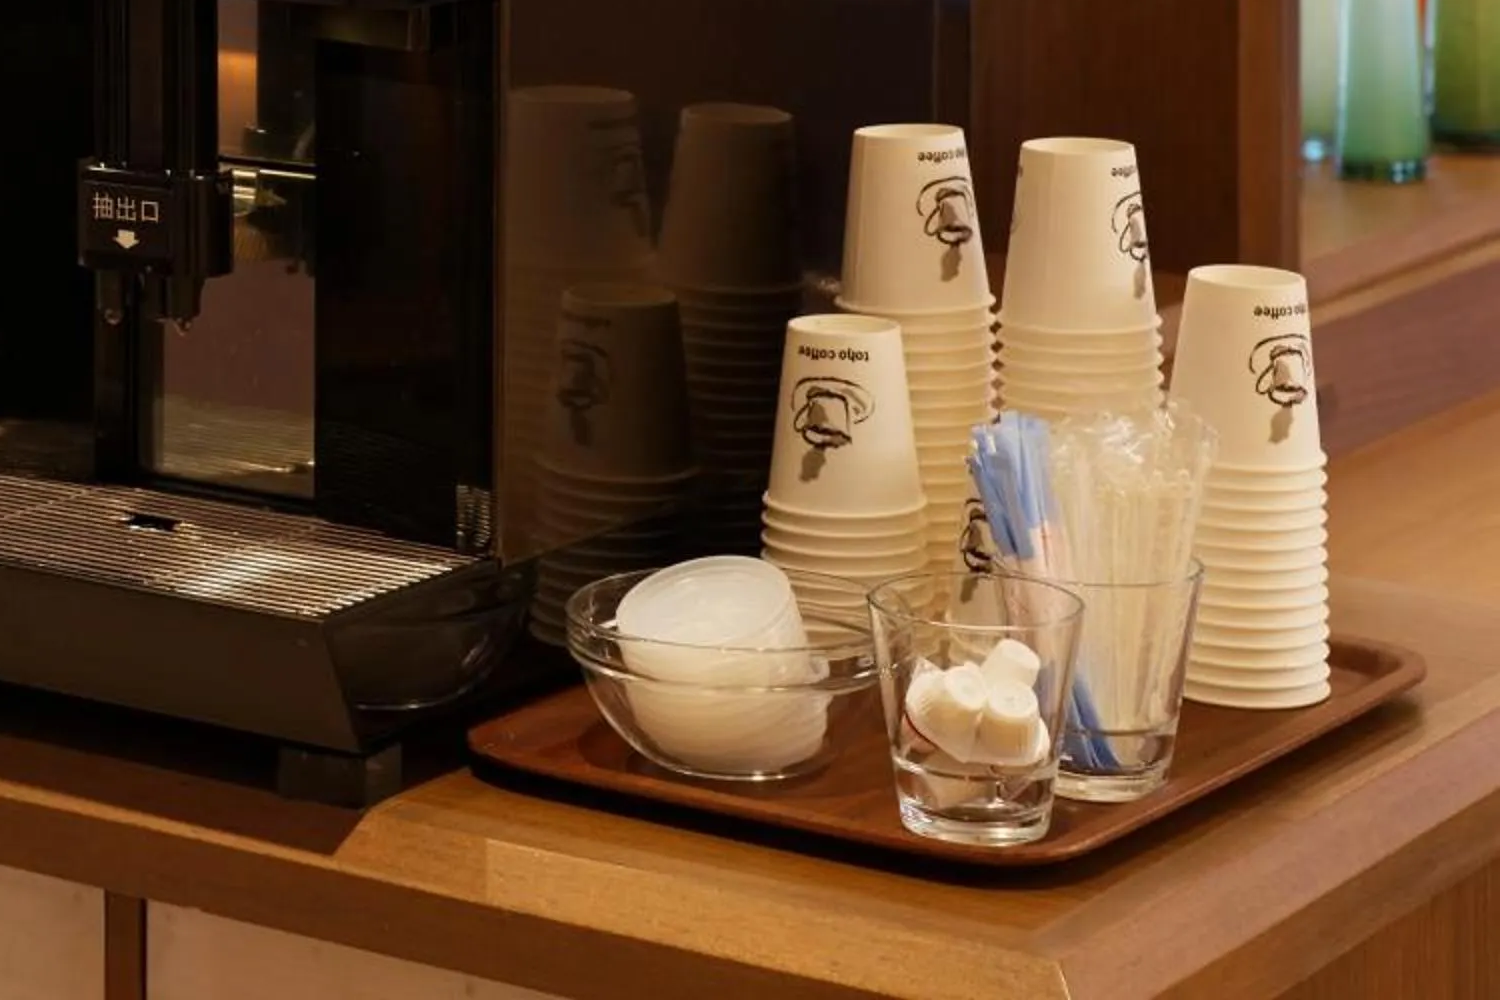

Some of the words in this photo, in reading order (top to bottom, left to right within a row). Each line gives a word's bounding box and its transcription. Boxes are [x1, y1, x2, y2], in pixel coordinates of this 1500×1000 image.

[93, 192, 160, 222] 抽出口
[1253, 305, 1293, 320] coffee
